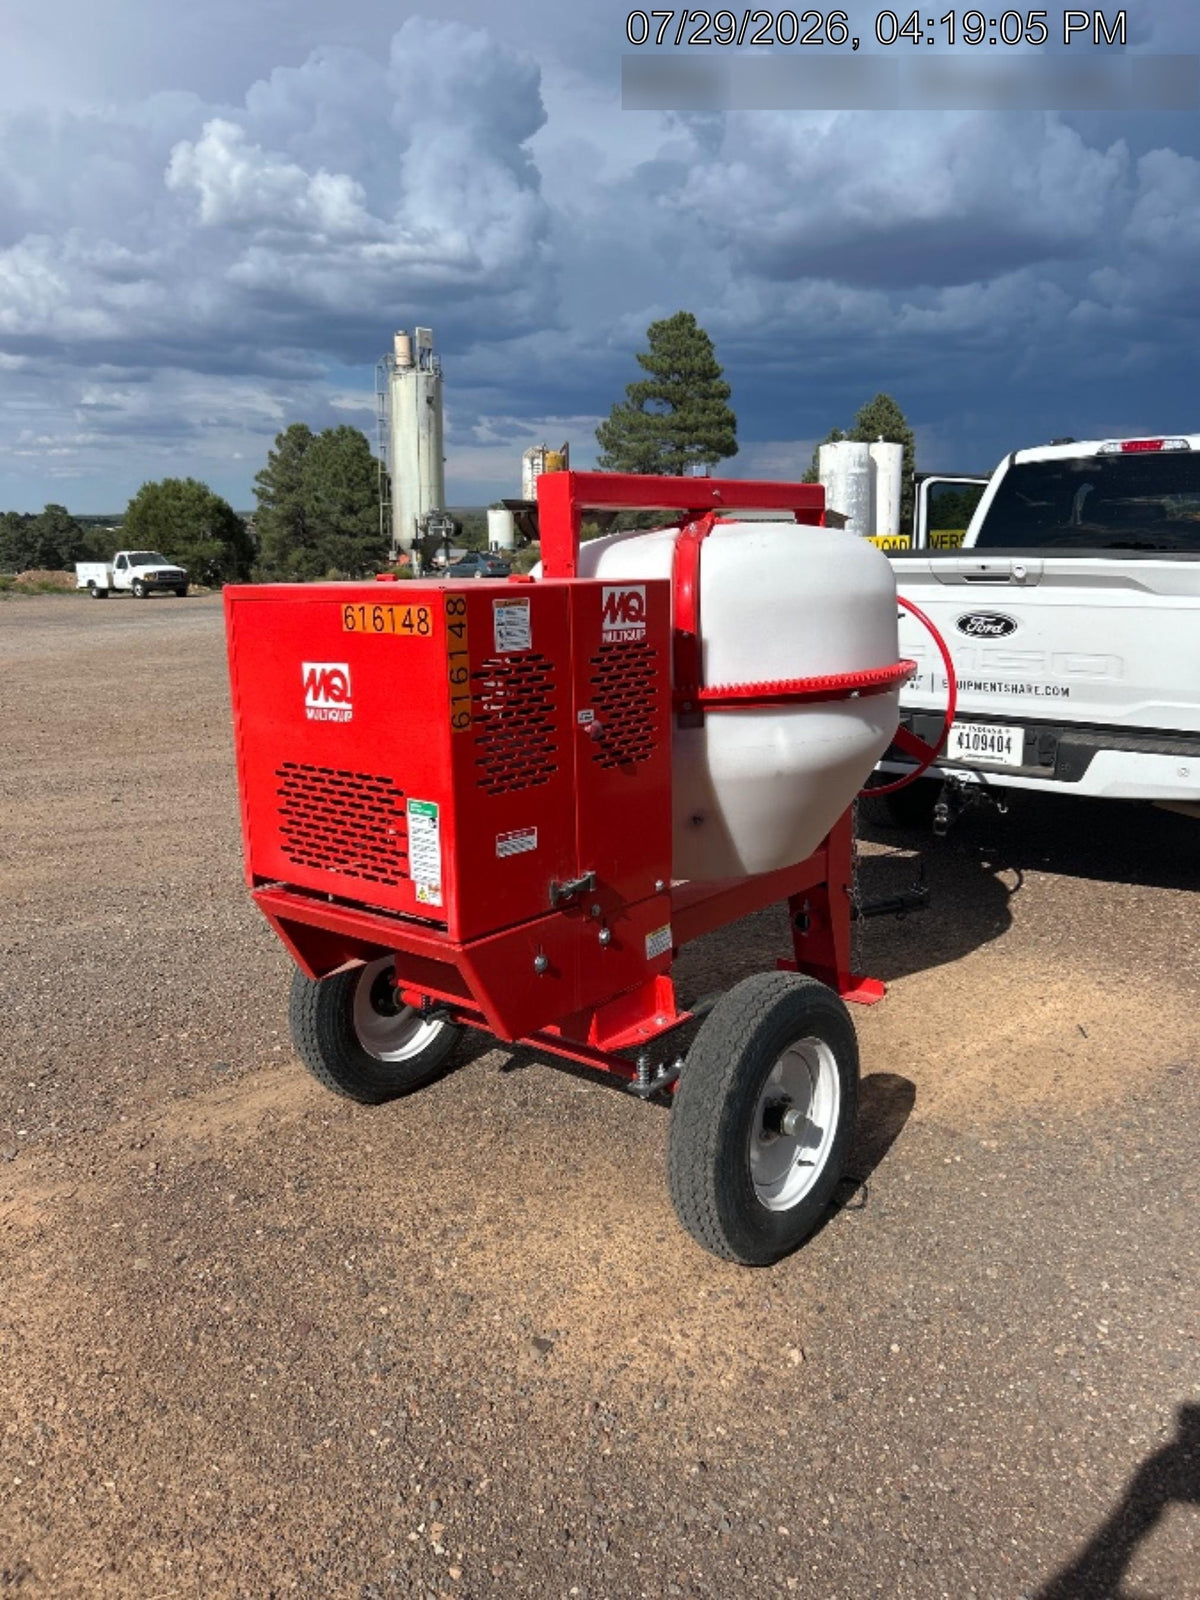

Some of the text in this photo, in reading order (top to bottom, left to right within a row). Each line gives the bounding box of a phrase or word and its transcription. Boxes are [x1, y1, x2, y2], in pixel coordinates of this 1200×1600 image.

[602, 590, 647, 625] MQ
[344, 605, 430, 635] 616148
[966, 616, 1005, 634] Ford
[602, 629, 647, 643] MULTIQUIP
[446, 597, 470, 729] 616148
[302, 667, 353, 704] MQ
[942, 678, 1071, 697] EUIPMENTSHARE.COM
[306, 707, 353, 722] MULTIQUIP
[956, 731, 1012, 755] 4109404
